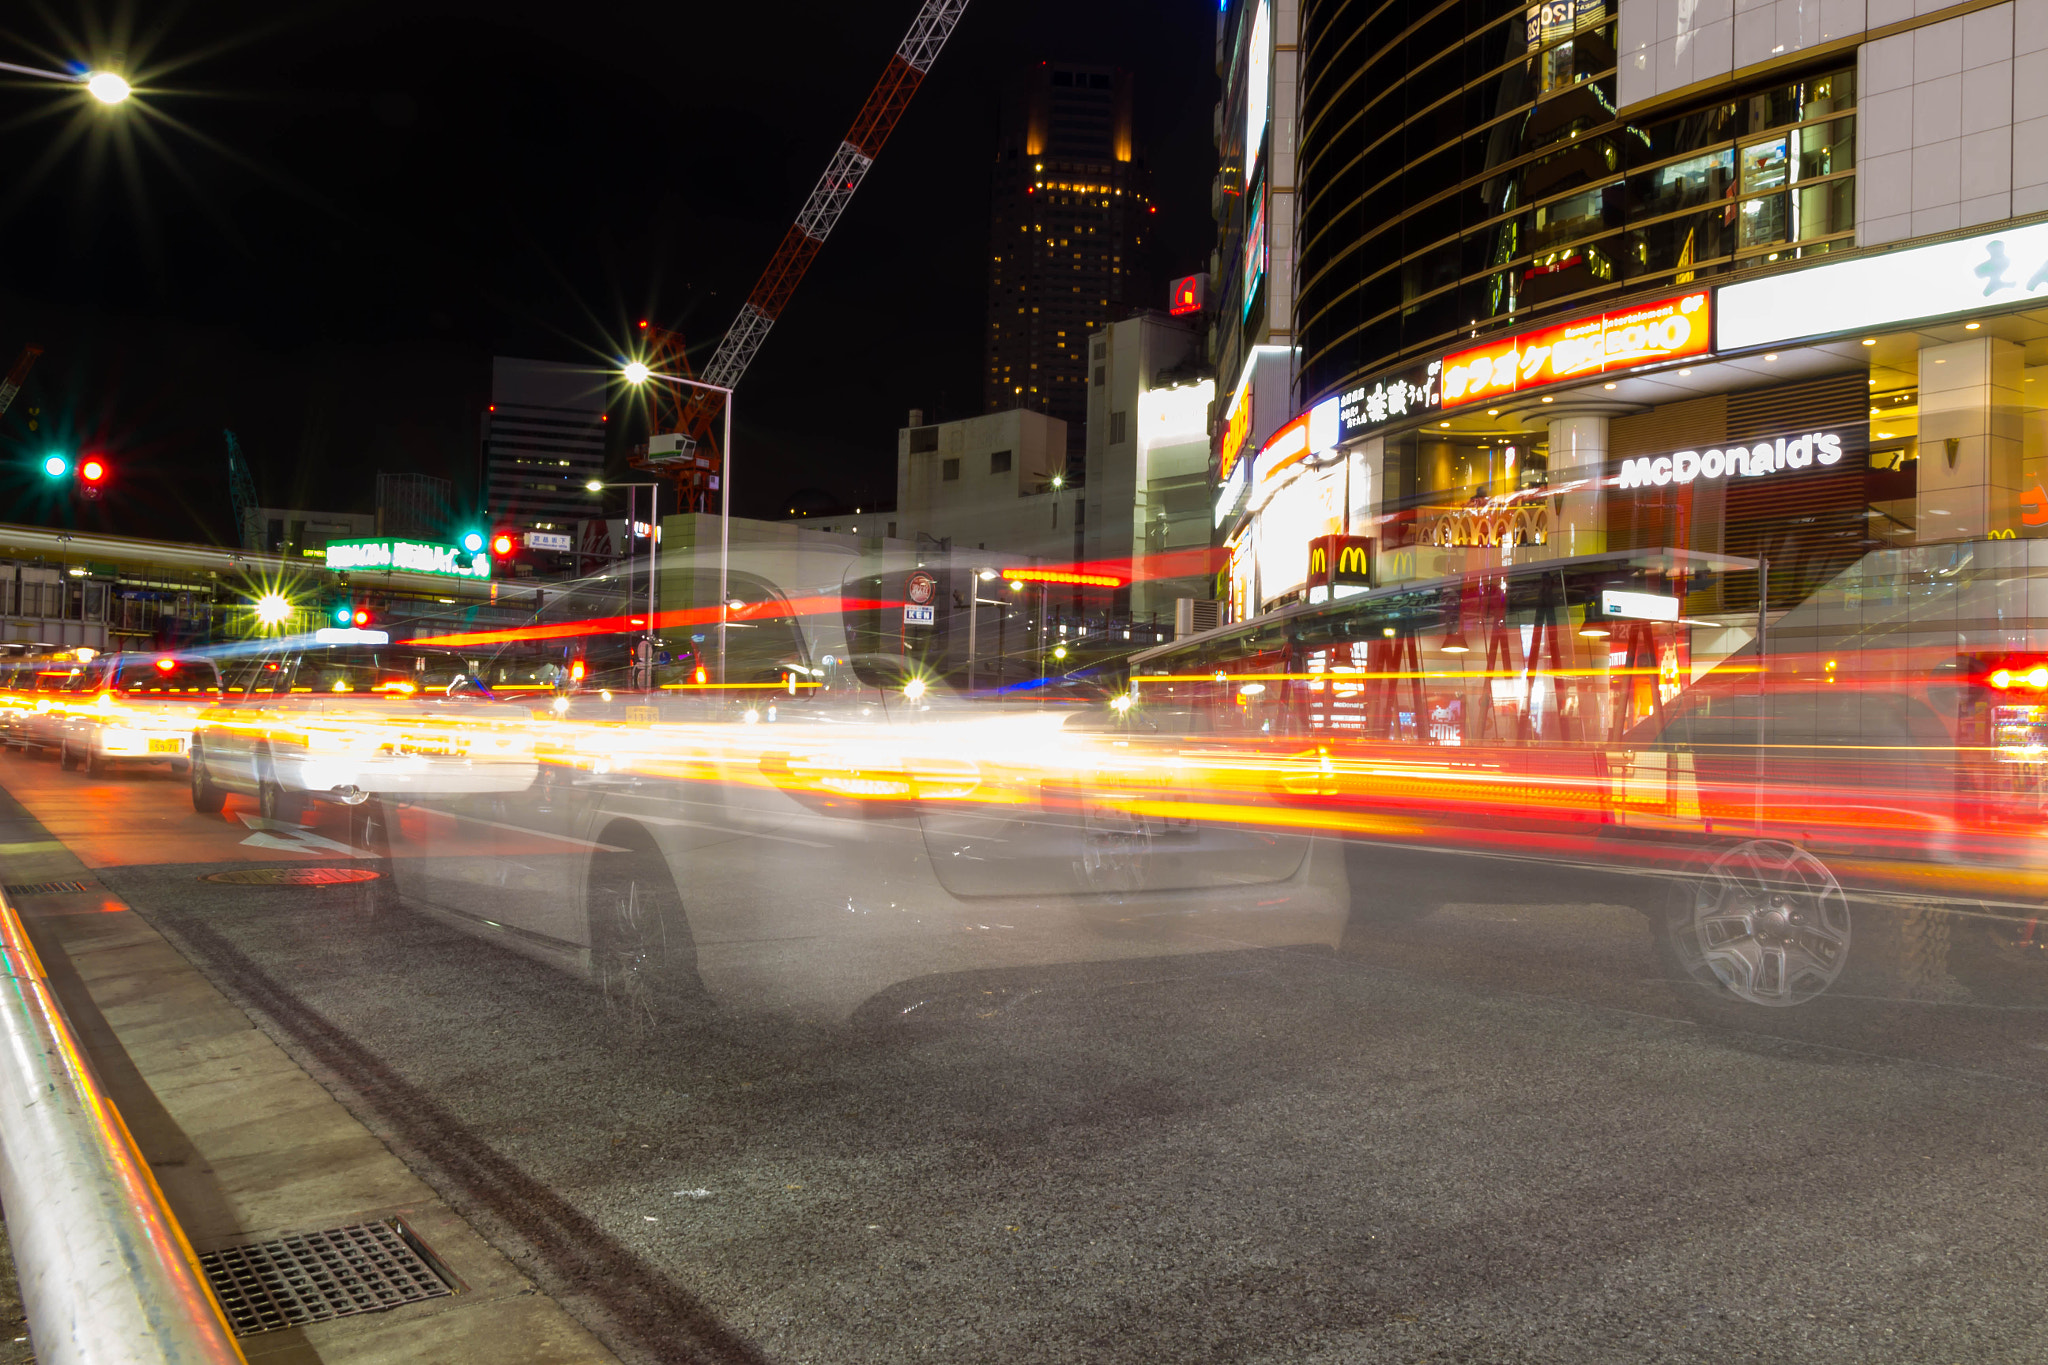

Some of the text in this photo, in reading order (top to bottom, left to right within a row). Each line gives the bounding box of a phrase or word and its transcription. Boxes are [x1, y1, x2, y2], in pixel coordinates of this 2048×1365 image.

[1444, 346, 1551, 400] カラオケ
[1620, 432, 1843, 489] McDonald's
